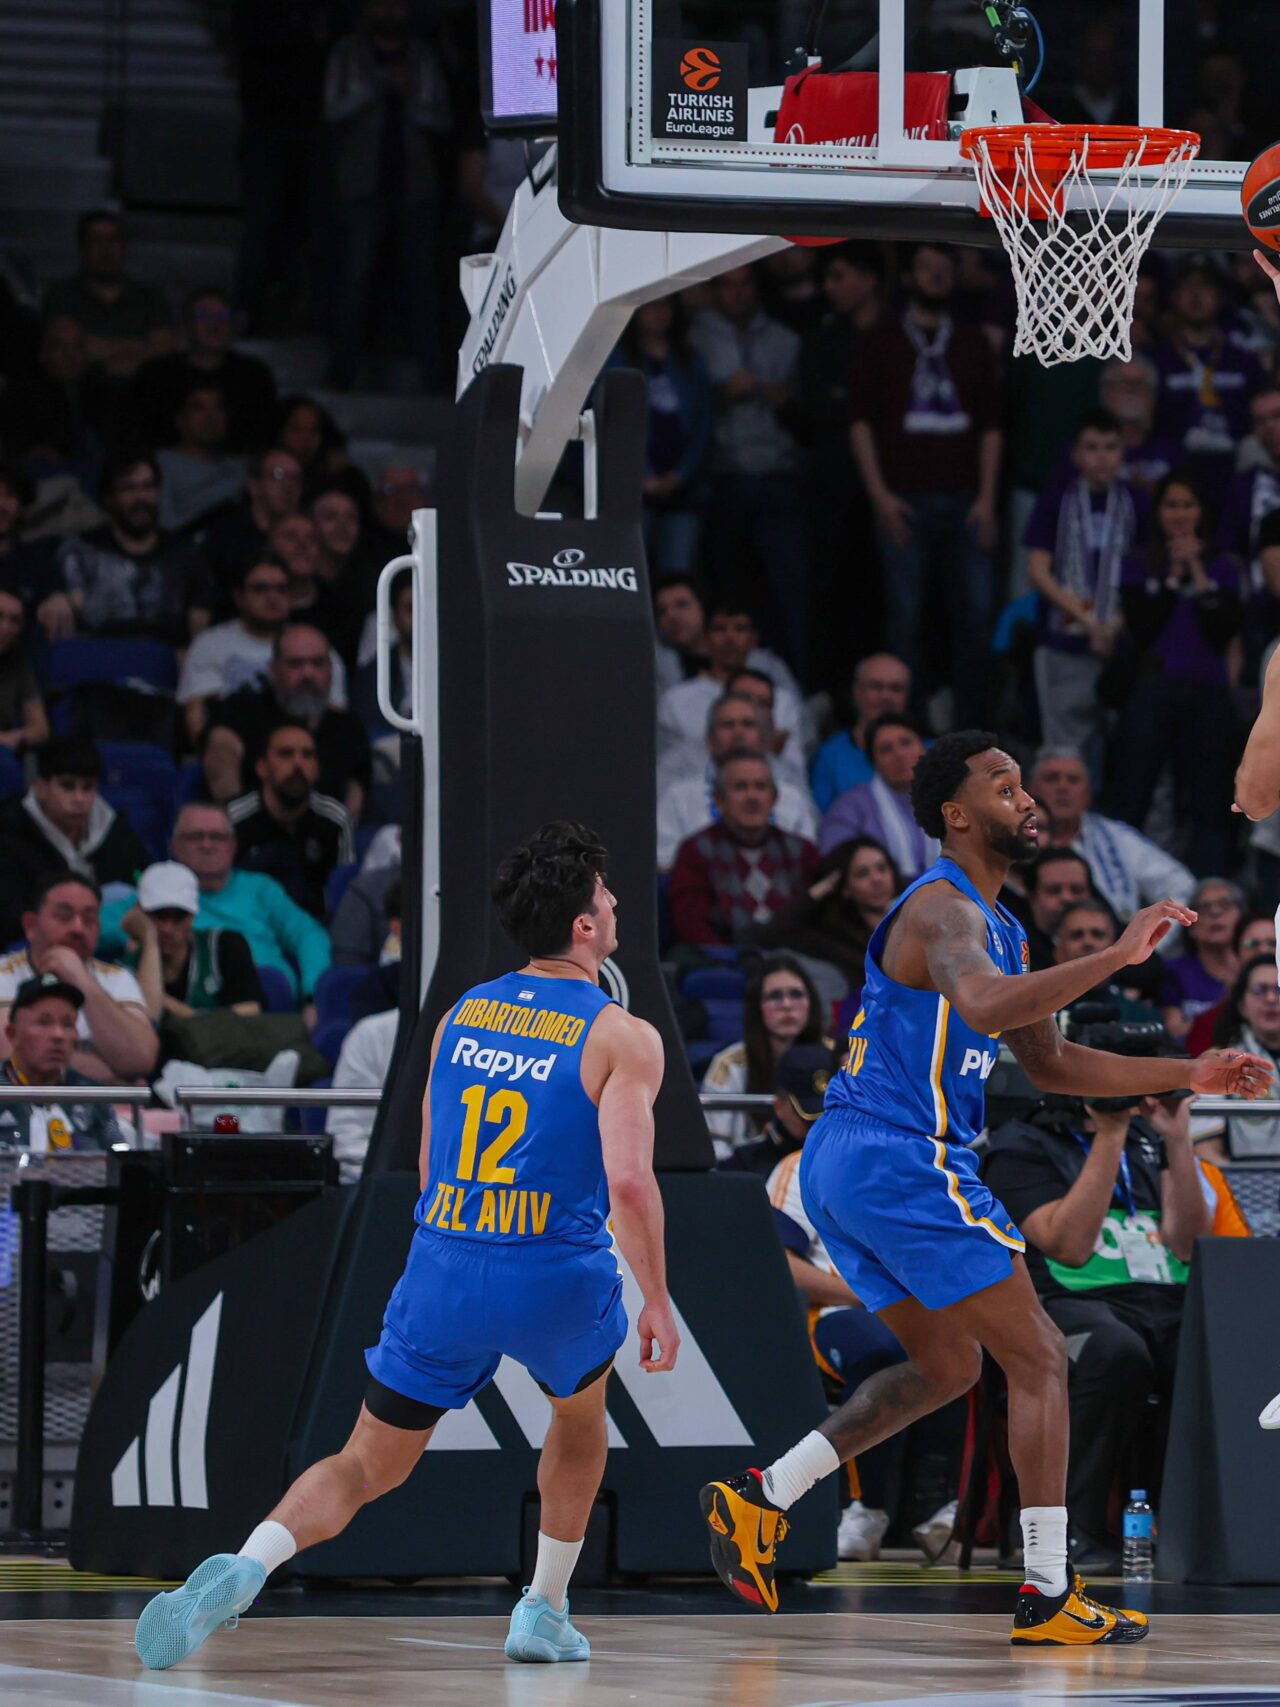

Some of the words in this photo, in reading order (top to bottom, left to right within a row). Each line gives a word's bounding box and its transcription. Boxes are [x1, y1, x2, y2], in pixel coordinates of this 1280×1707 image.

[667, 108, 734, 122] AIRLINES
[668, 93, 733, 109] TURKISH
[665, 122, 735, 138] EuroLeague
[473, 265, 517, 377] SPALDING
[506, 562, 638, 591] SPALDING
[452, 998, 586, 1047] DIBARTOLOMEO
[451, 1037, 557, 1081] Rapyd
[456, 1084, 529, 1184] 12
[425, 1182, 468, 1231] TEL
[475, 1190, 551, 1235] AVIV
